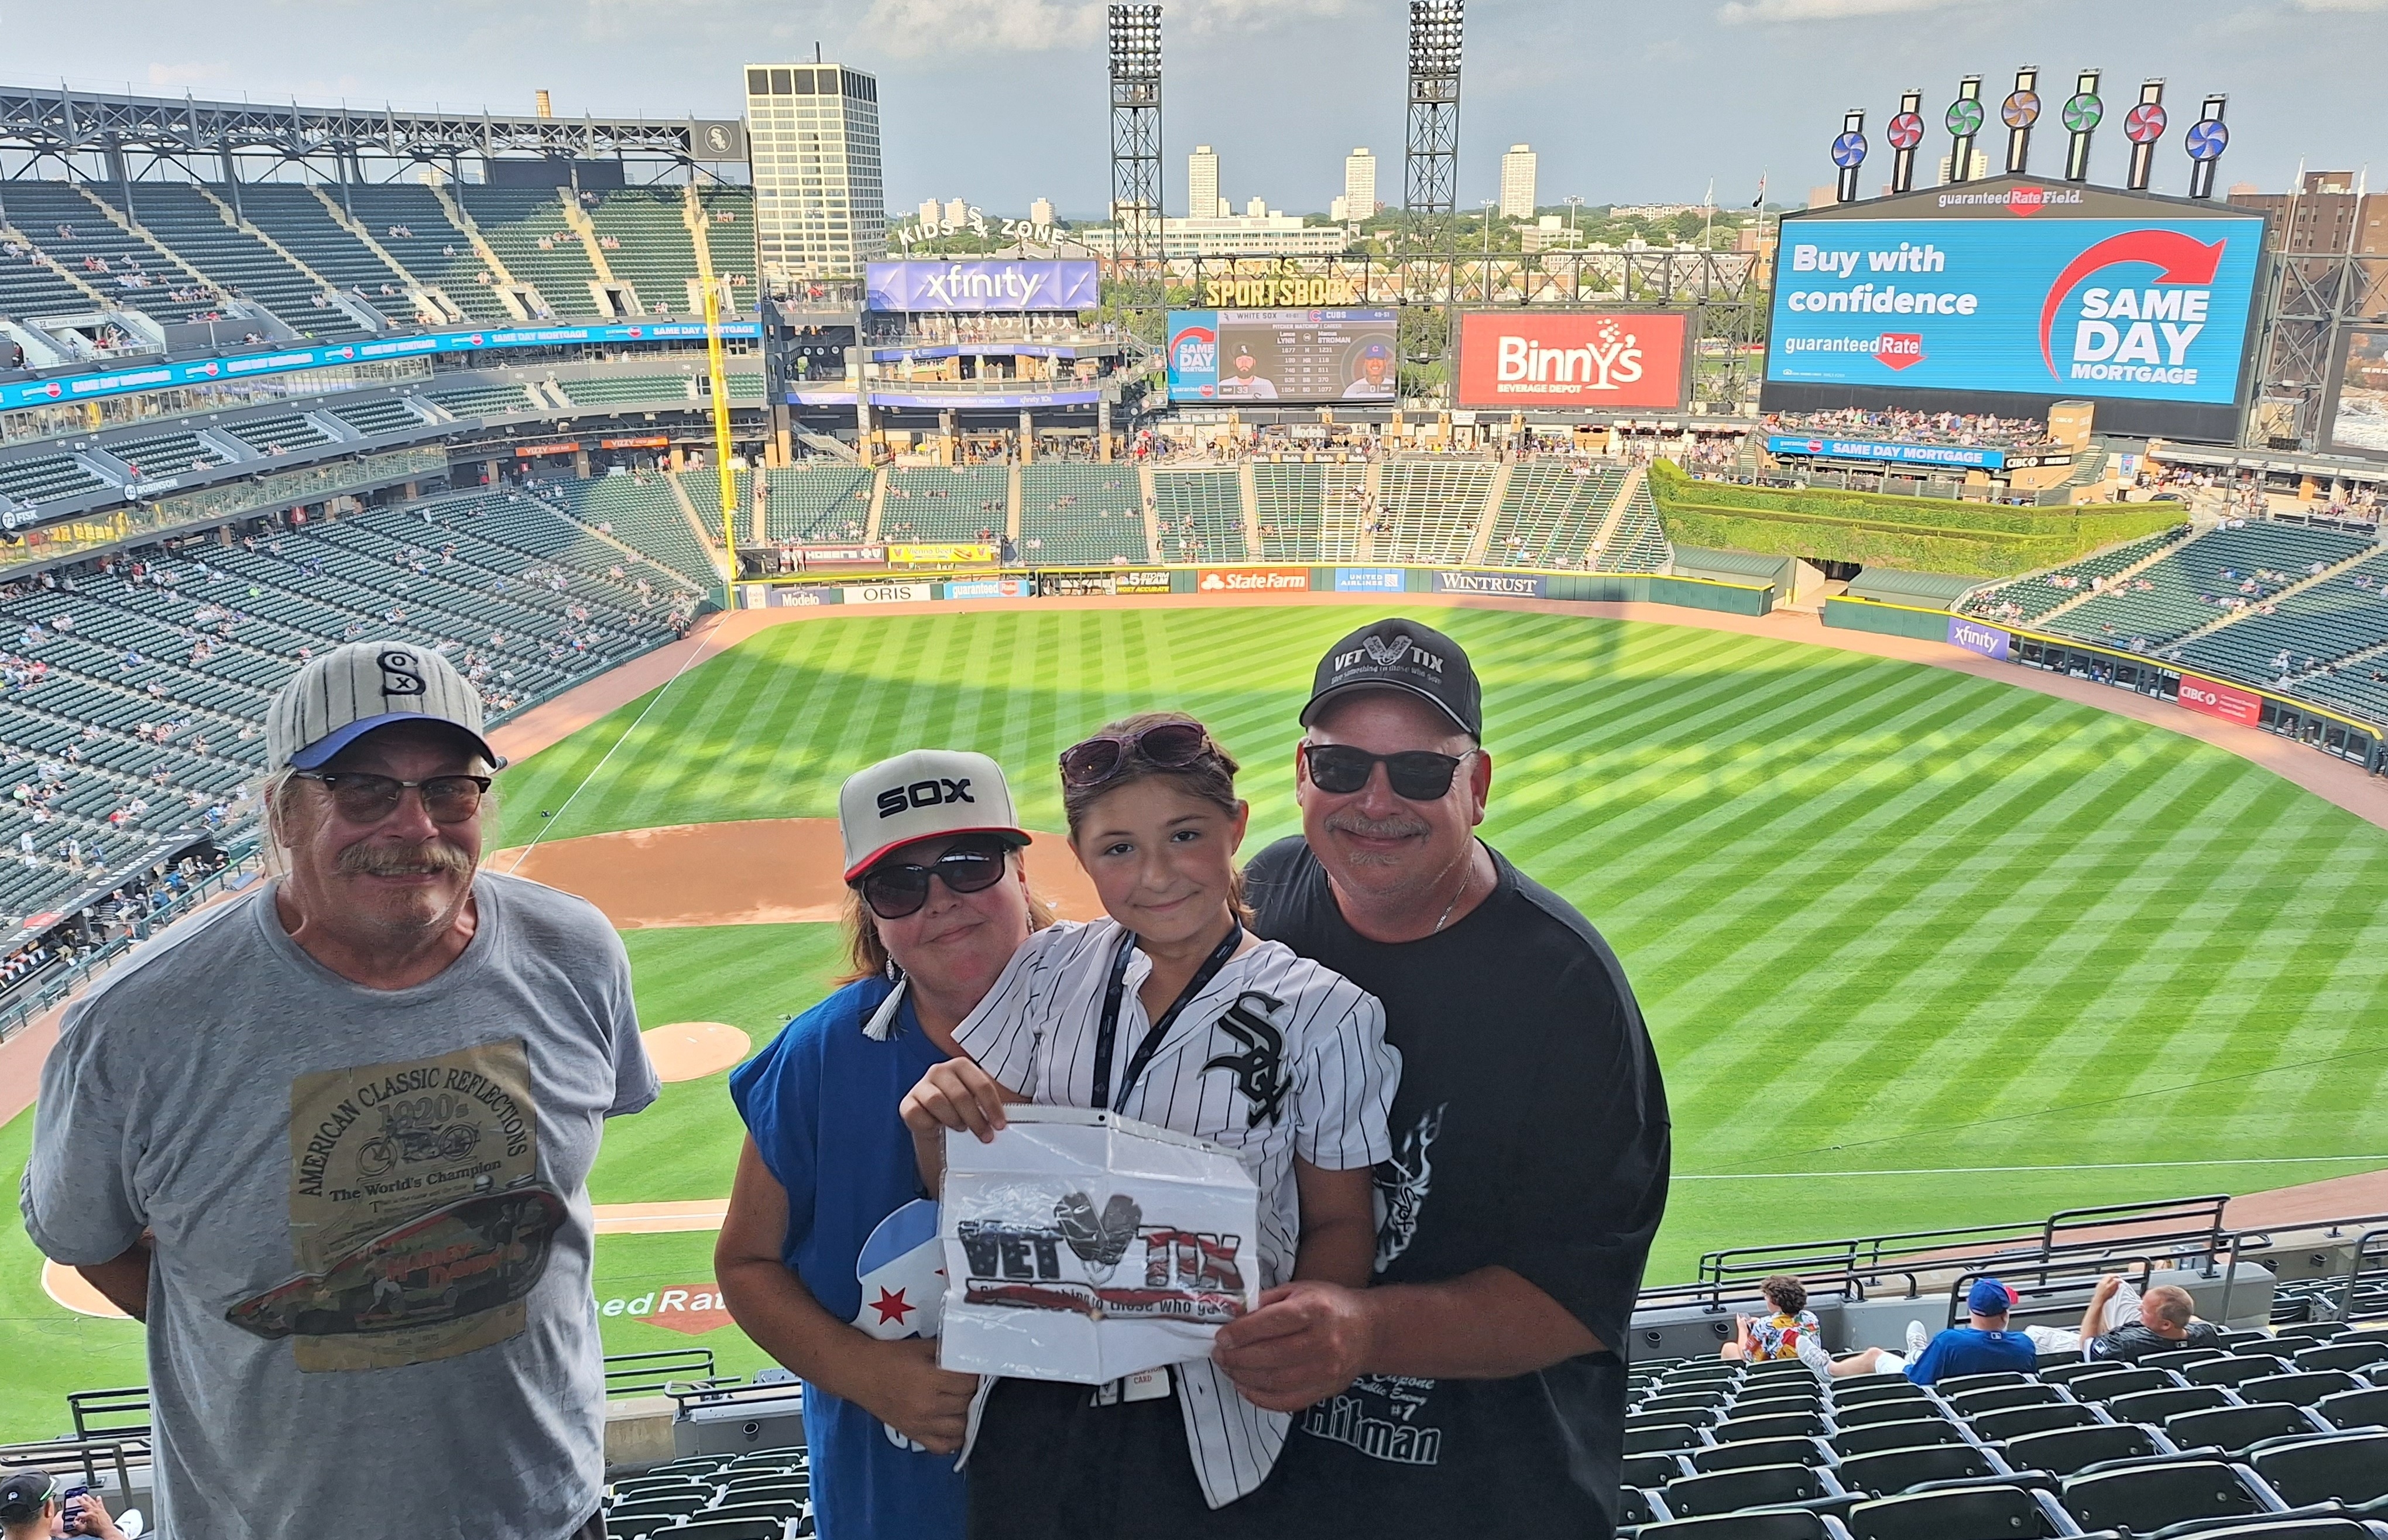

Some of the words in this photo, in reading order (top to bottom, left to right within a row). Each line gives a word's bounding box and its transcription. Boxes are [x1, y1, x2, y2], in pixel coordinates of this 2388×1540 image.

[2012, 191, 2040, 204] Rate
[897, 218, 955, 246] KIDS
[1001, 218, 1066, 246] ZONE
[1207, 258, 1295, 276] CAESARS
[1793, 244, 1860, 279] Buy
[1868, 242, 1945, 272] with
[927, 265, 1039, 306] xfinity
[1206, 279, 1356, 306] SPORTSBOOK
[1788, 283, 1978, 315] confidence
[2080, 287, 2210, 321] SAME
[492, 332, 516, 343] SAME
[517, 331, 536, 341] DAY
[538, 329, 588, 341] MORTGAGE
[653, 327, 680, 335] SAME
[682, 326, 701, 335] DAY
[1180, 344, 1214, 354] SAME
[1785, 336, 1879, 354] guaranteed
[1881, 337, 1920, 354] Rate
[2073, 320, 2205, 365] DAY
[1180, 354, 1214, 366] DAY
[2071, 363, 2198, 385] MORTGAGE
[1497, 383, 1547, 393] BEVERAGE
[1549, 384, 1582, 393] DEPOT
[526, 446, 548, 455] VIZZY
[1832, 442, 1870, 455] SAME
[1872, 444, 1900, 457] DAY
[1903, 447, 1983, 464] MORTGAGE
[125, 487, 135, 496] 42
[137, 478, 178, 495] ROBINSON
[4, 515, 13, 525] 72
[16, 509, 38, 523] FISK
[1129, 572, 1140, 585] 5
[1440, 572, 1538, 593] WINTRUST
[864, 586, 911, 601] ORIS
[952, 582, 999, 598] guaranteed
[782, 593, 819, 607] Modelo
[1954, 625, 1999, 654] xfinity
[1334, 649, 1365, 672] VET
[1411, 646, 1444, 673] TIX
[2180, 686, 2206, 702] CIBC
[877, 778, 975, 819] SOX
[378, 1093, 469, 1131] 1920's
[299, 1099, 361, 1198] AMERICAN
[358, 1068, 440, 1107] CLASSIC
[444, 1068, 527, 1158] REFLECTIONS
[330, 1188, 361, 1202] The
[364, 1177, 421, 1196] World's
[426, 1160, 502, 1186] Champion
[958, 1220, 1068, 1280] VET
[1137, 1225, 1246, 1291] TIX
[658, 1289, 727, 1313] Rat
[1159, 1298, 1192, 1314] who
[1134, 1375, 1152, 1384] CARD
